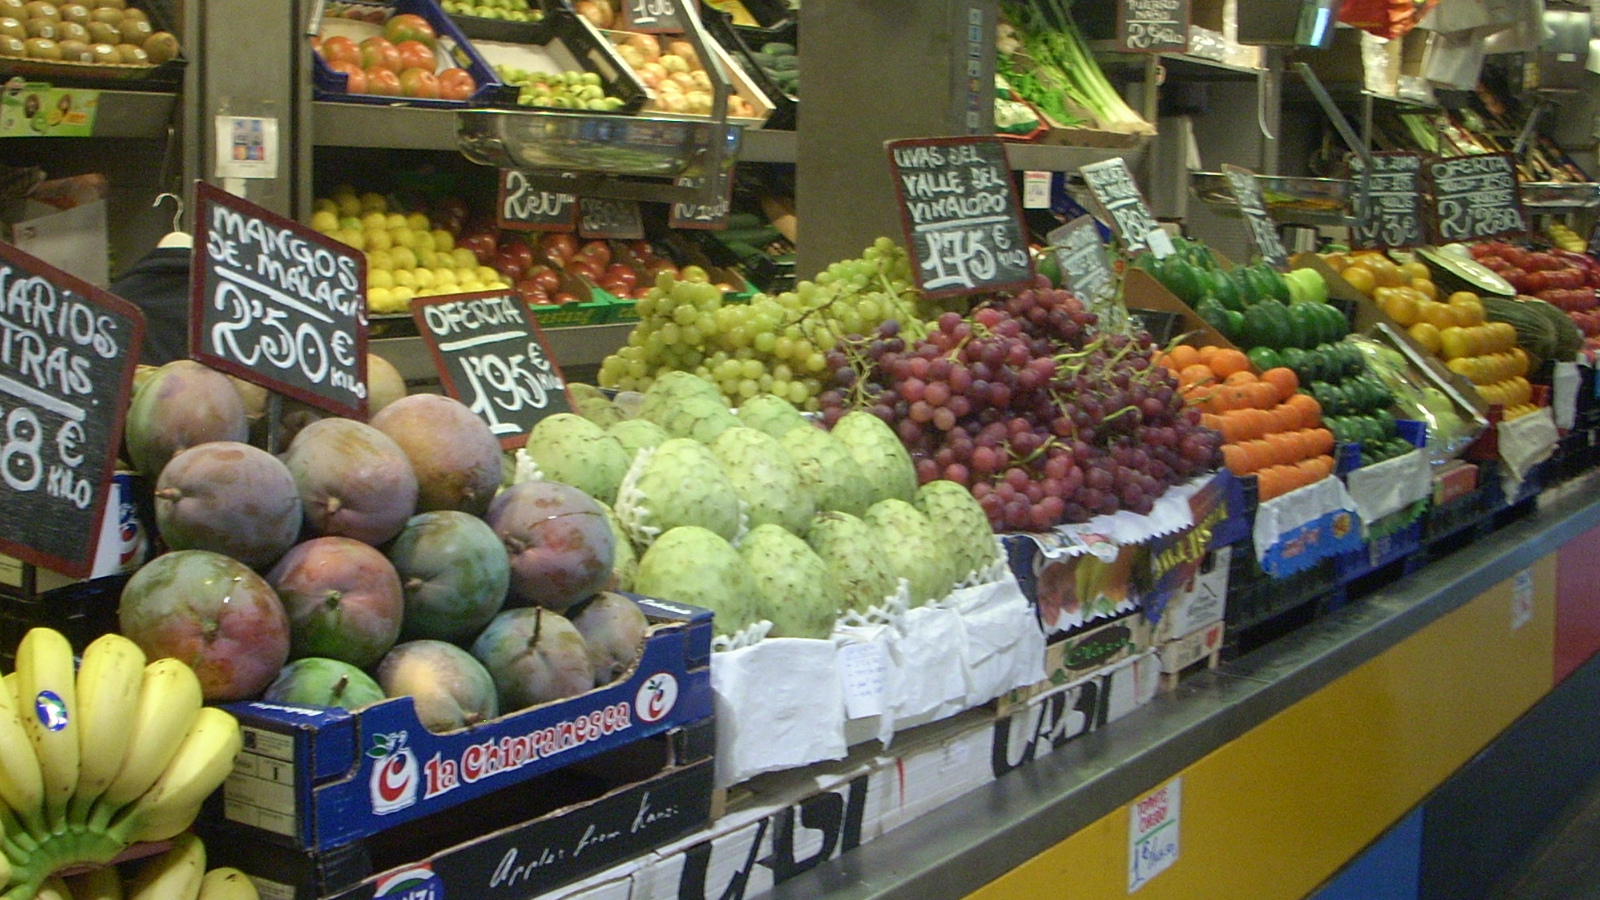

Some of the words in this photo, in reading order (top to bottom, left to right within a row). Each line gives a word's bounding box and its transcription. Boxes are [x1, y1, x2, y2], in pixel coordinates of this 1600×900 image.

[901, 171, 965, 198] VALLE
[1431, 156, 1513, 178] OFERTA
[214, 206, 359, 291] MANGOS
[424, 295, 525, 336] OFERTA
[331, 366, 367, 399] KILO
[48, 465, 91, 509] KILO
